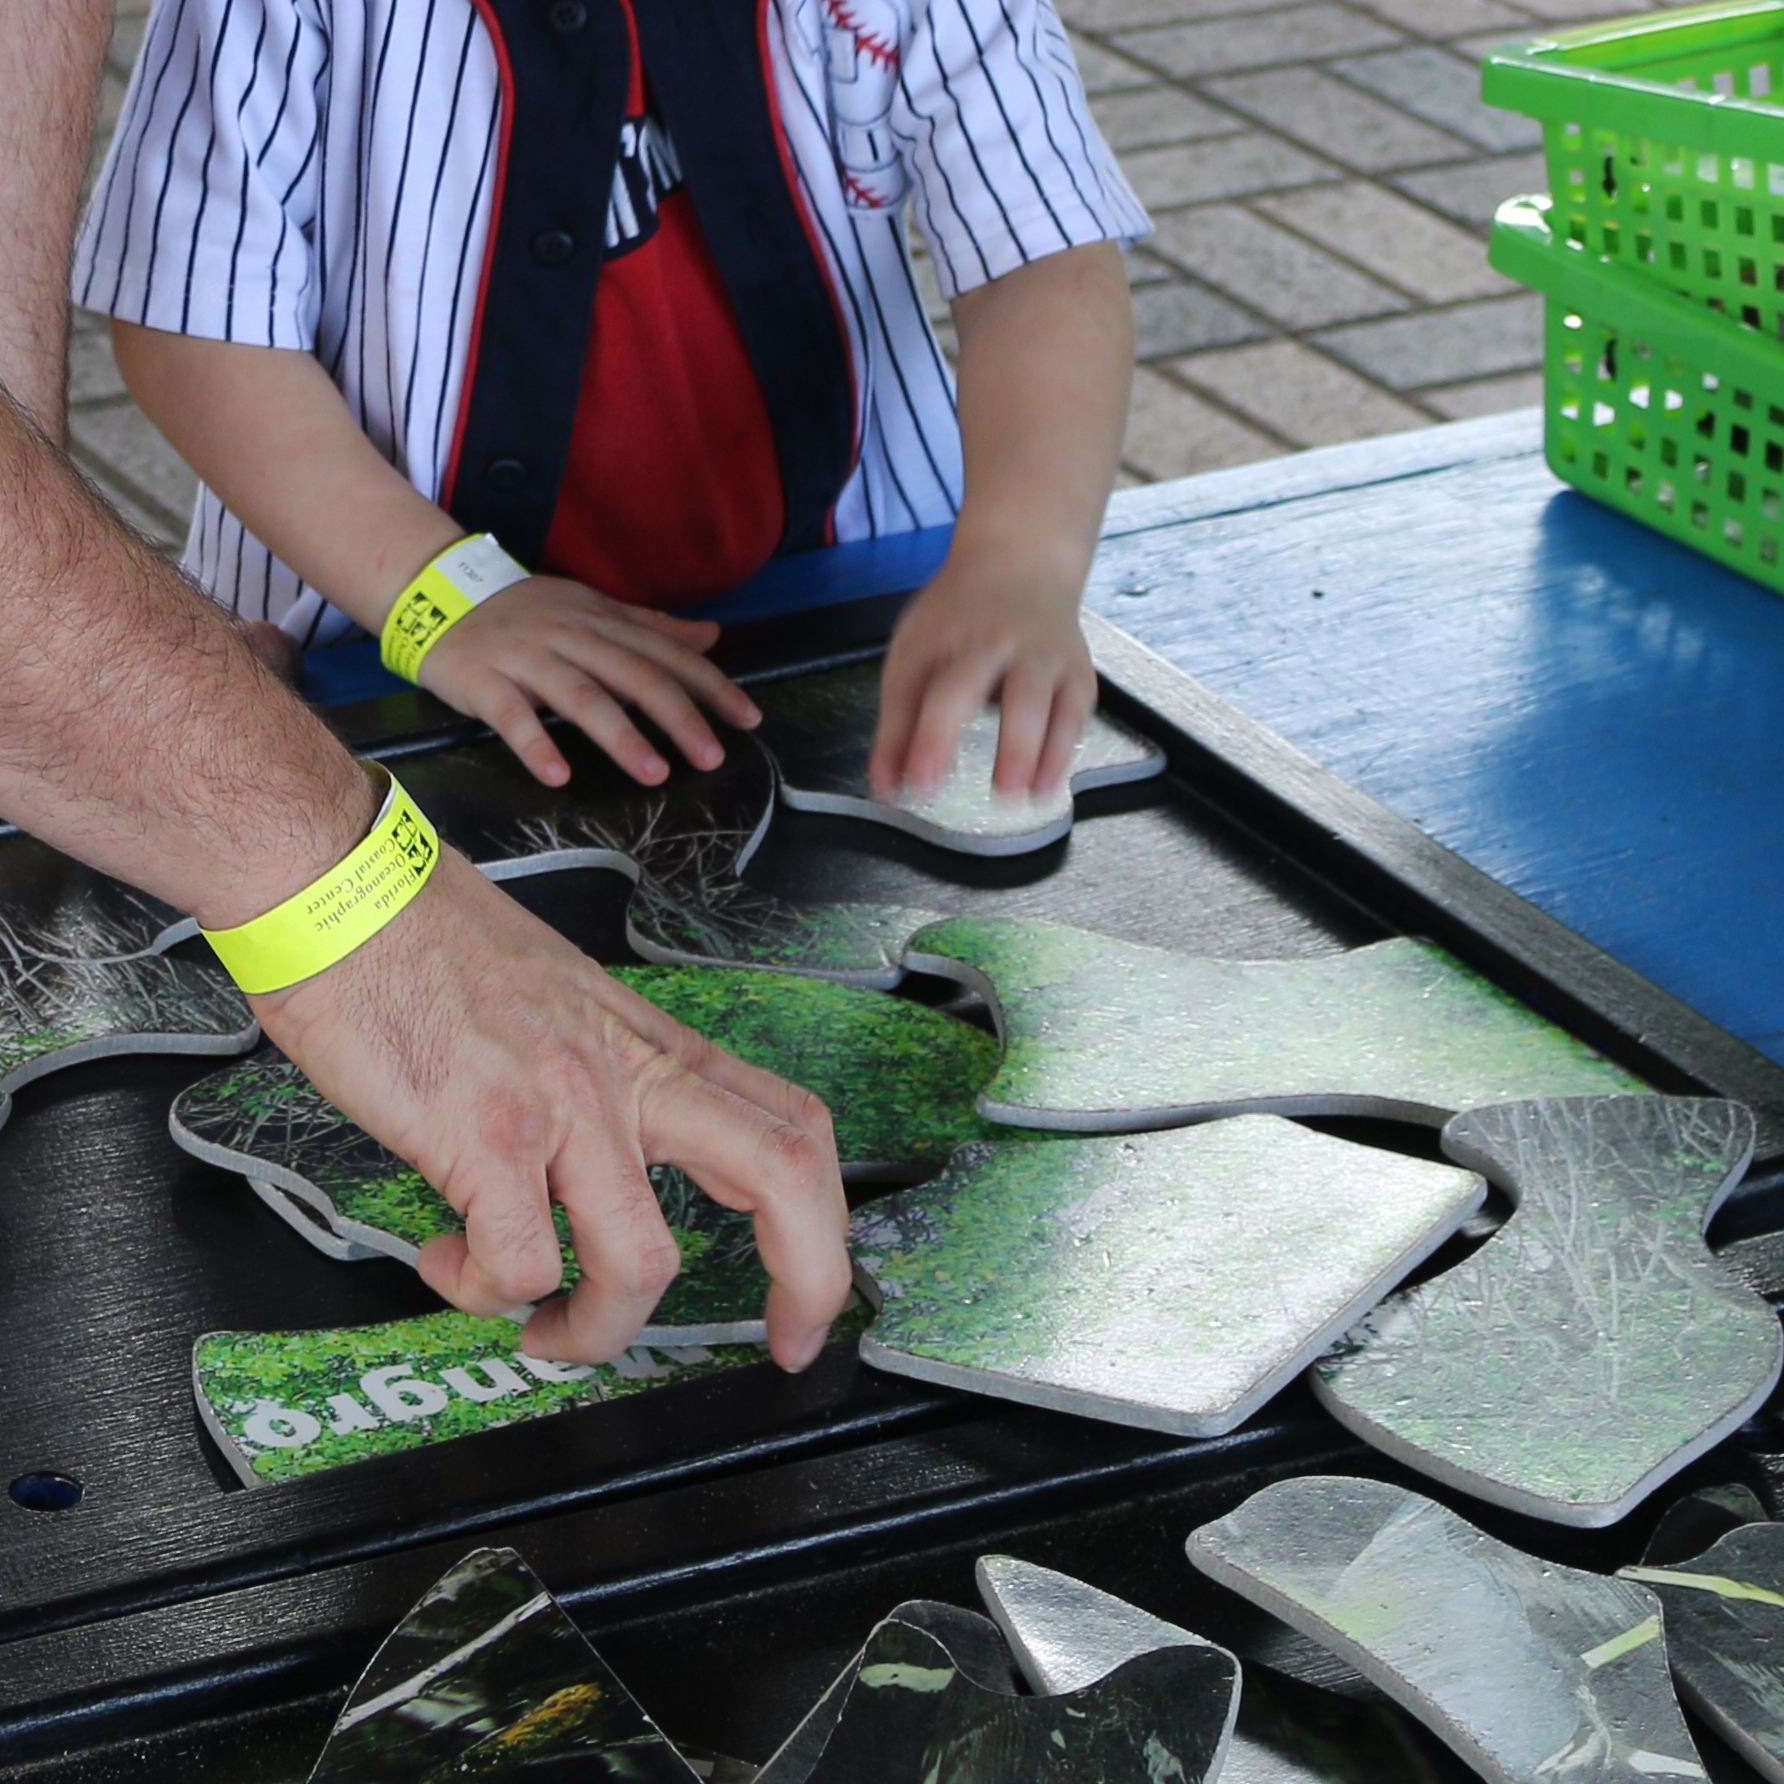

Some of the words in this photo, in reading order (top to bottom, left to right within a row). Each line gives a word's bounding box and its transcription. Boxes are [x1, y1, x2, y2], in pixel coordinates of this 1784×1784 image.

[354, 837, 396, 883] Coastal
[306, 878, 354, 915] Center
[315, 853, 406, 932] Oceanographic
[374, 867, 420, 910] Florida
